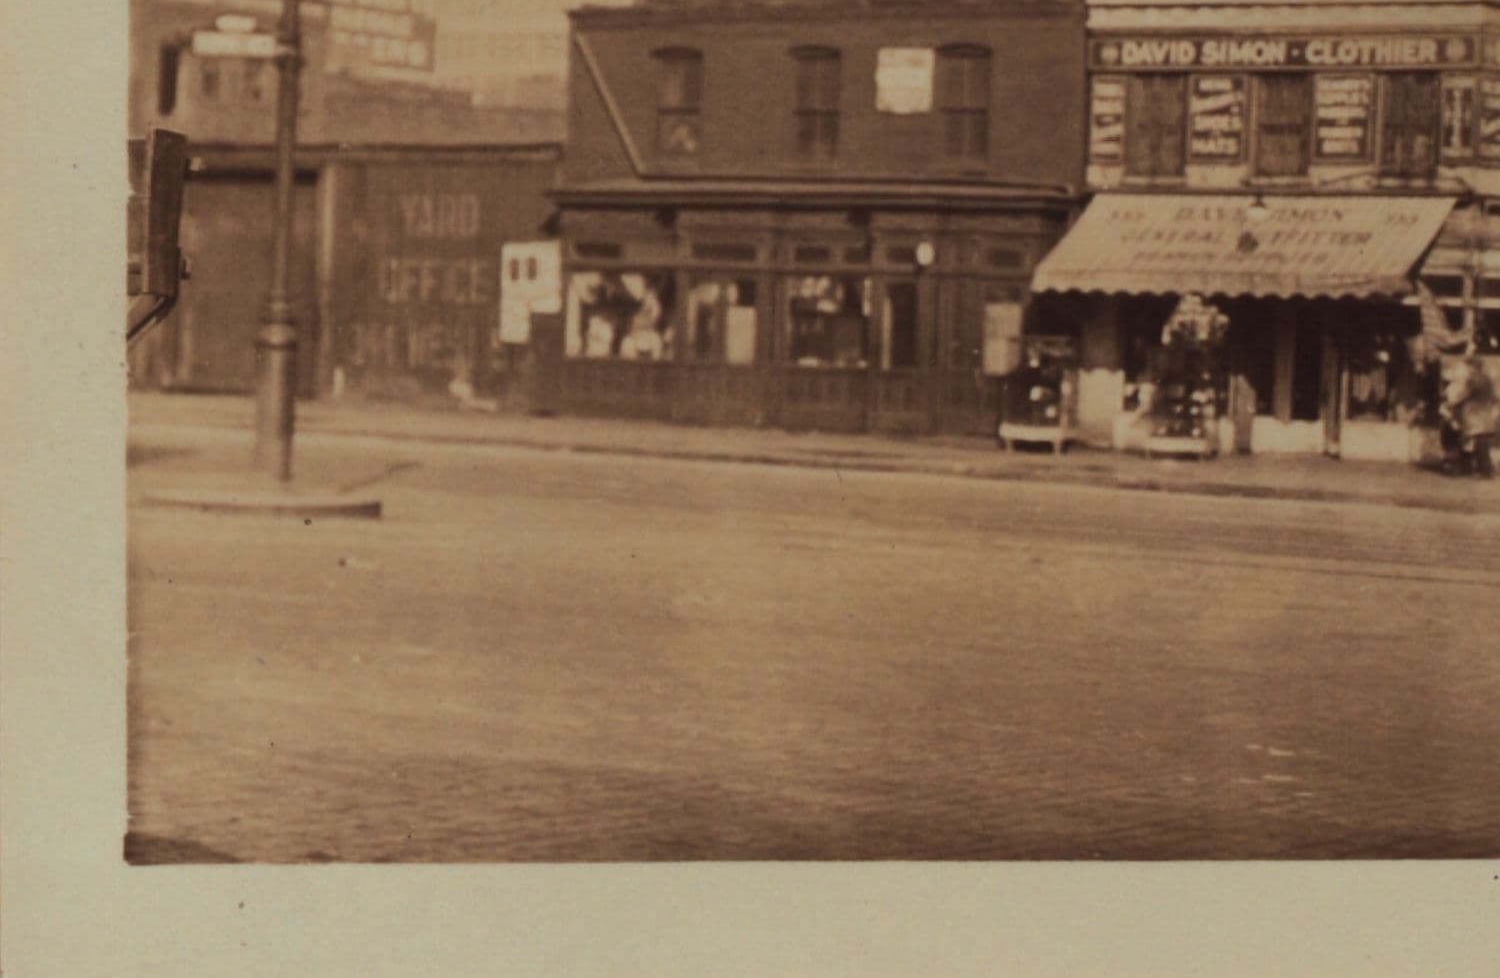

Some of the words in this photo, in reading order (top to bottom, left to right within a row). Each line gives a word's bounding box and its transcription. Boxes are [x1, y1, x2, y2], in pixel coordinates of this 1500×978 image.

[1121, 40, 1196, 64] DAVID
[1200, 40, 1286, 64] SIMON
[1305, 39, 1438, 64] CLOTHIER
[399, 193, 480, 238] YARD
[1120, 226, 1224, 244] GENERAL
